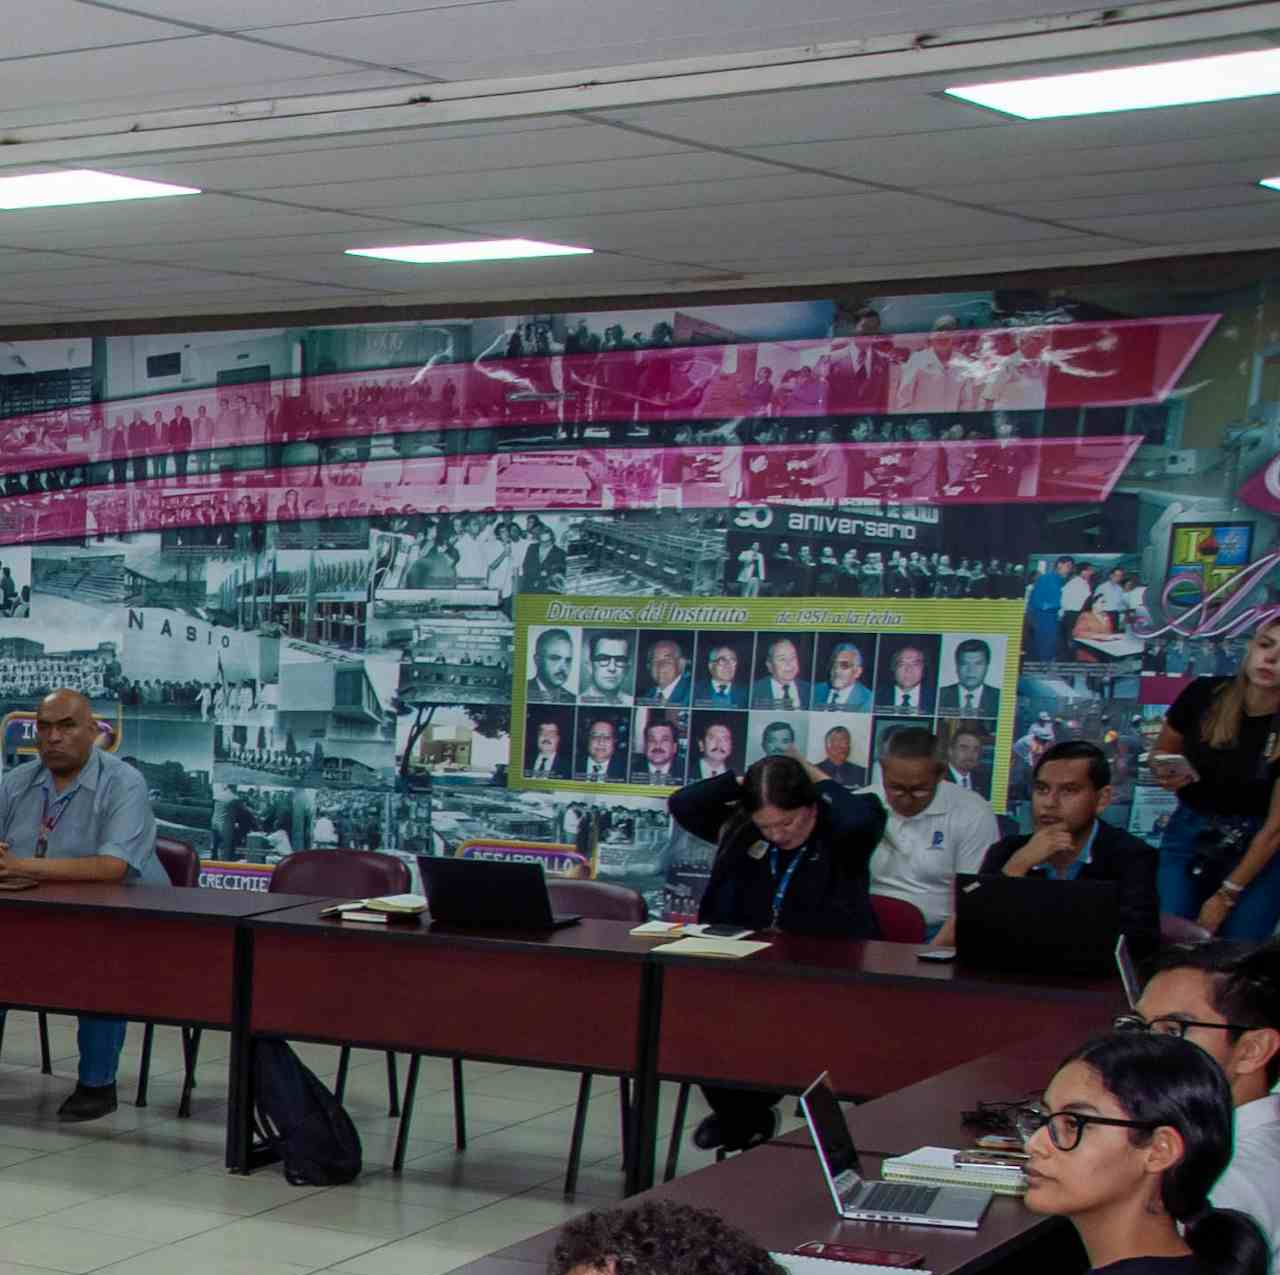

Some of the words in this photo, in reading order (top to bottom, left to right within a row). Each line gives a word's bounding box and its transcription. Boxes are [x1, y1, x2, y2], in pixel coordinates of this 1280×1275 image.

[788, 512, 917, 540] aniversario
[547, 601, 635, 622] Directores
[638, 600, 662, 623] del
[669, 603, 749, 624] Instituto
[128, 609, 230, 648] NASIO
[198, 873, 270, 892] CRECIMIE
